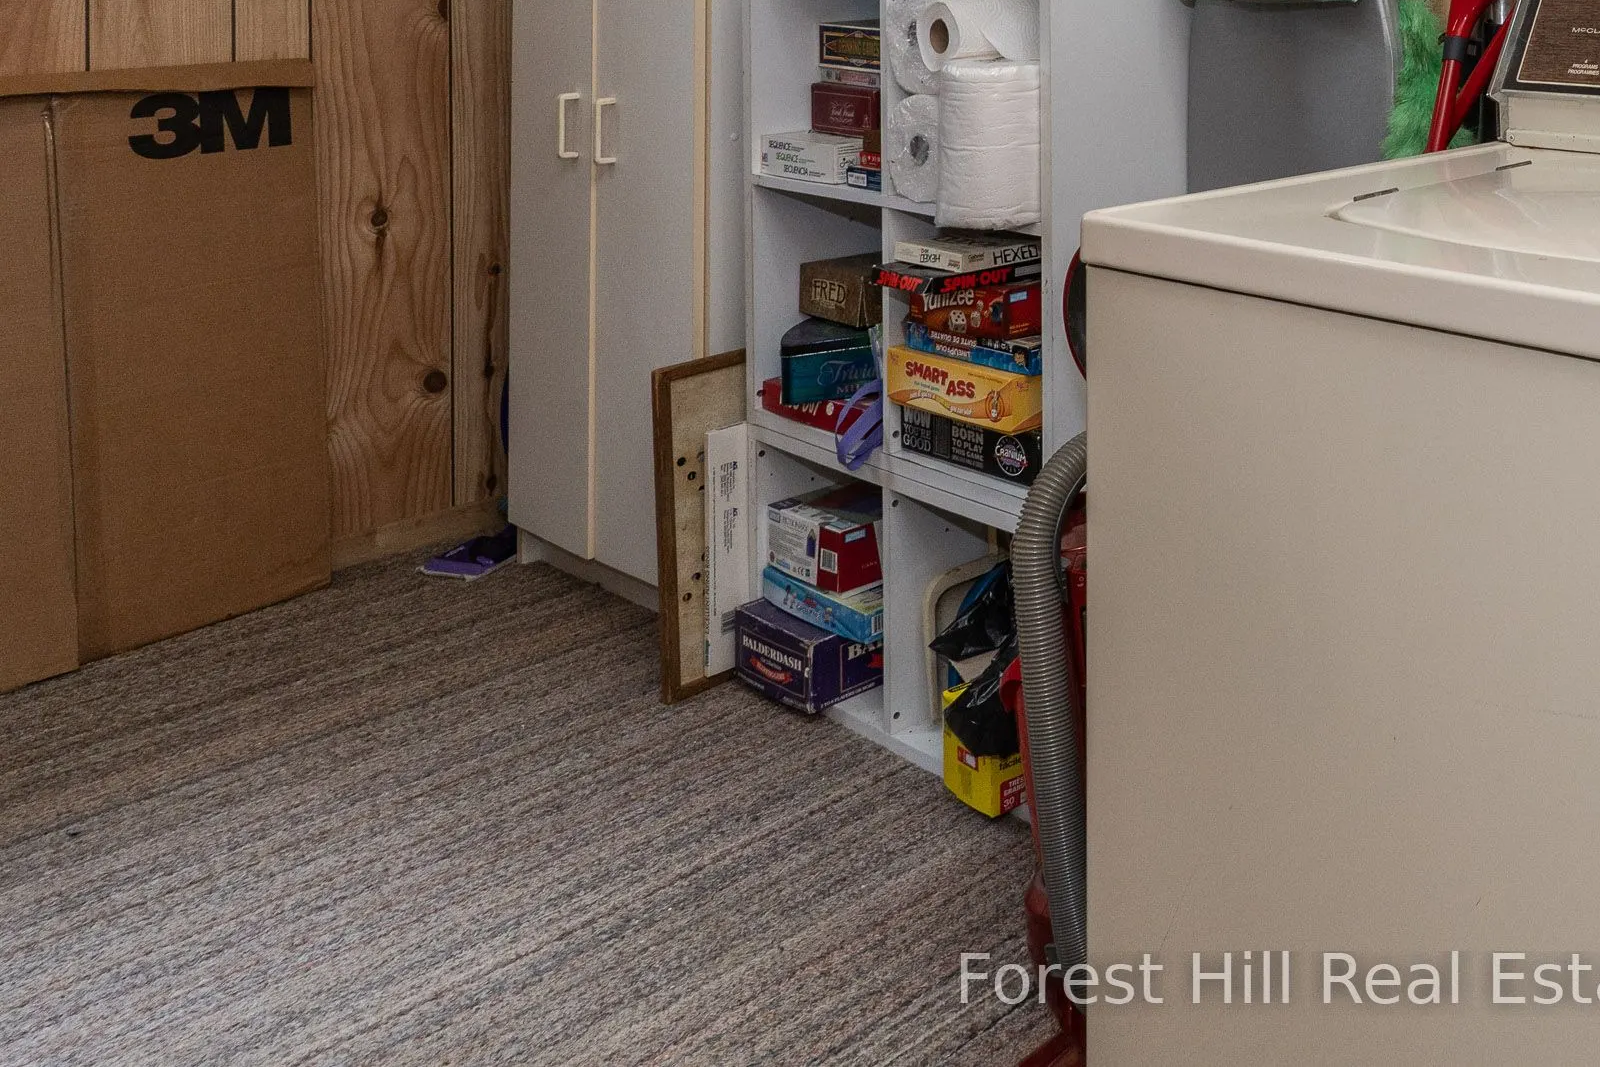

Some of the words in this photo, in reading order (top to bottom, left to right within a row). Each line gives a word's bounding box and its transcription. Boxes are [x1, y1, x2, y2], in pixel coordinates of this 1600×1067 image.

[126, 87, 294, 160] 3M
[768, 140, 792, 152] SEQUENCE
[776, 152, 800, 164] SEQUENCE
[992, 244, 1039, 266] HEXED
[812, 279, 846, 304] FRED
[906, 360, 948, 386] SMART
[946, 380, 976, 398] ASS
[904, 408, 931, 429] WOW
[903, 434, 931, 452] GOOD
[952, 426, 984, 446] BORN
[952, 437, 962, 448] TO
[963, 441, 984, 454] PLAY
[952, 446, 966, 458] THIS
[966, 450, 984, 462] GAME
[742, 634, 802, 672] BALDERDASH
[1003, 796, 1015, 808] 30
